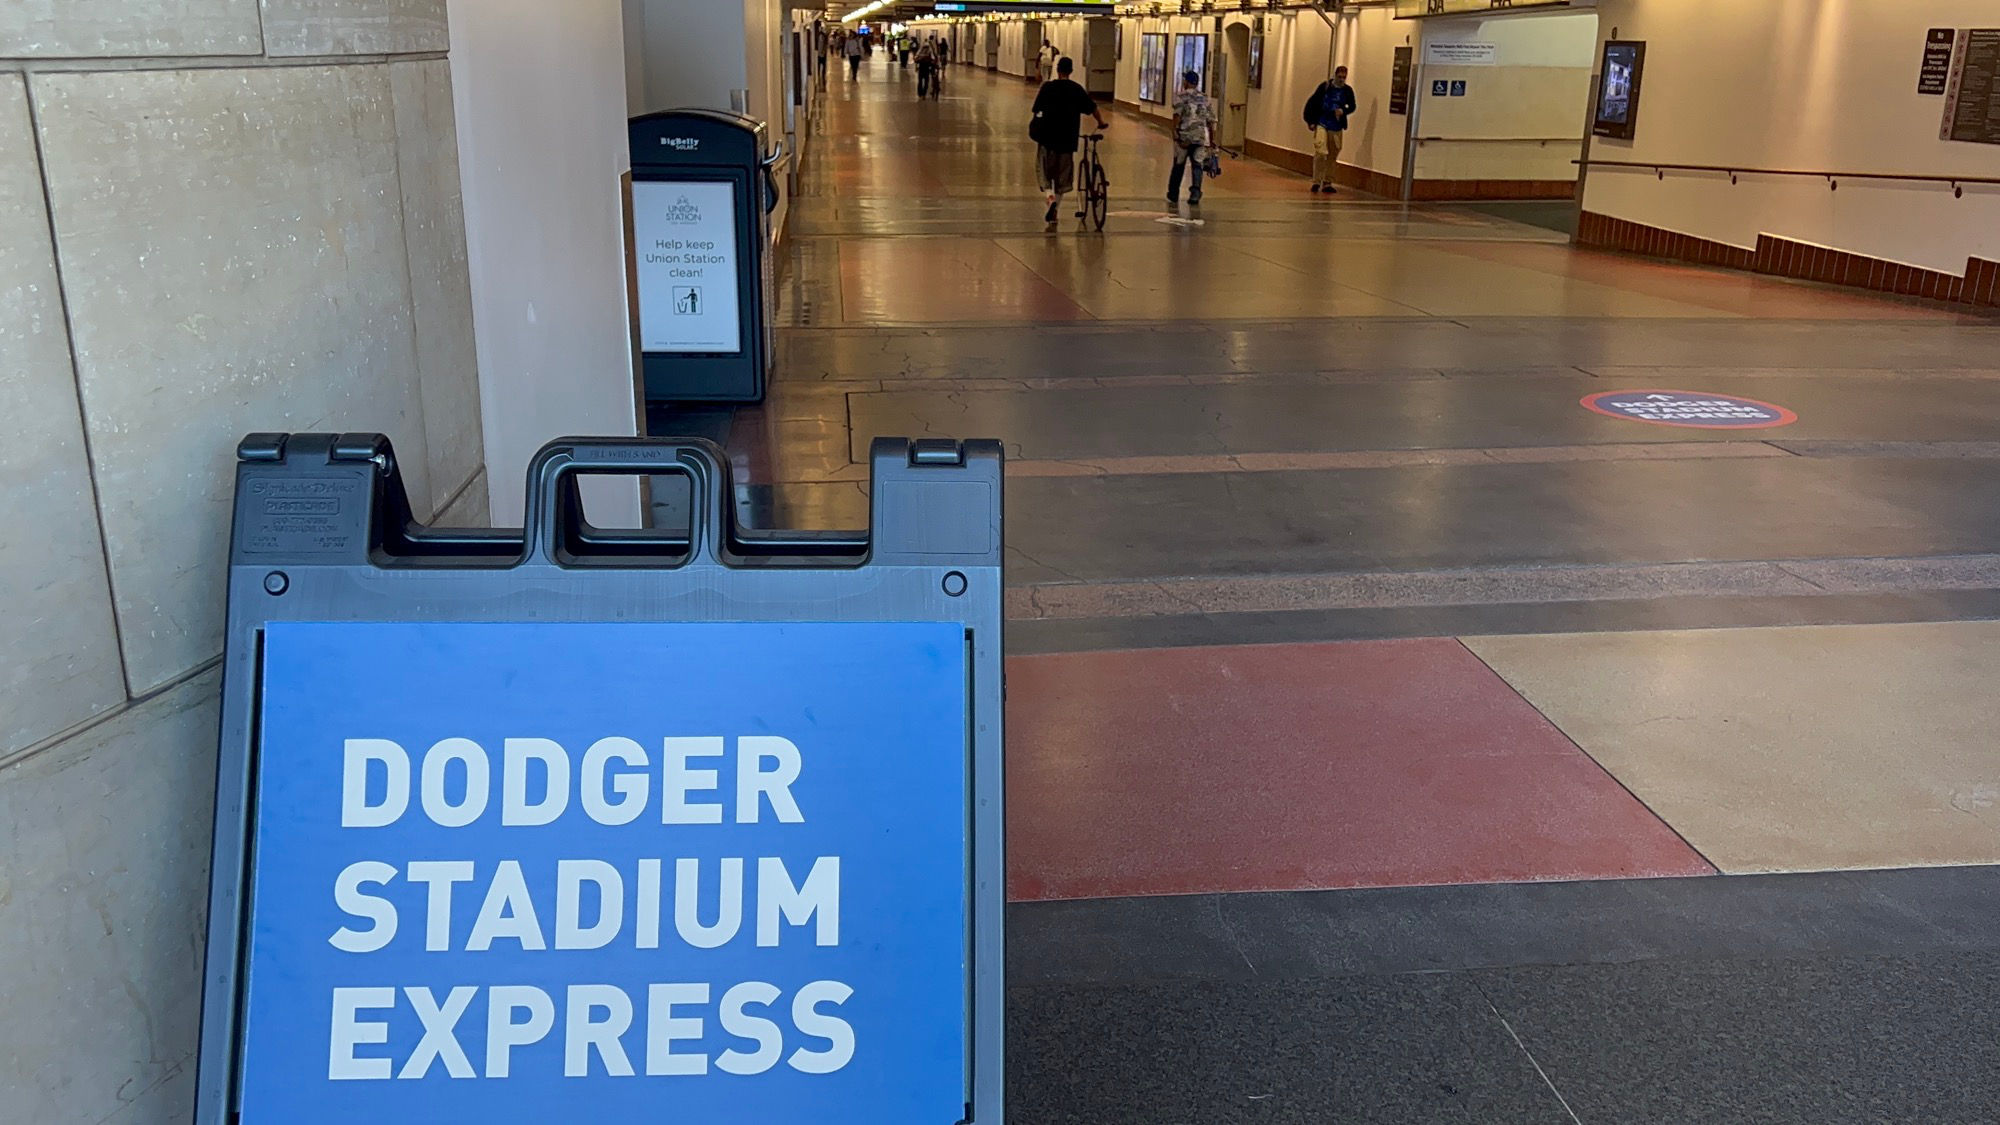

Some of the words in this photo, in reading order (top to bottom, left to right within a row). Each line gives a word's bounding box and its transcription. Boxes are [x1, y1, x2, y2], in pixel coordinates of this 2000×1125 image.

[660, 136, 699, 147] BigBelly
[667, 204, 699, 213] UNION
[665, 212, 702, 221] STATION
[655, 239, 683, 251] Help
[686, 239, 714, 251] keep
[646, 253, 680, 264] Union
[683, 253, 725, 264] Station
[669, 267, 703, 278] clean!
[1624, 406, 1761, 414] STADIUM
[1638, 411, 1772, 420] EXPRESS
[341, 735, 805, 828] DODGER
[328, 856, 840, 953] STADIUM
[328, 980, 855, 1080] EXPRESS
